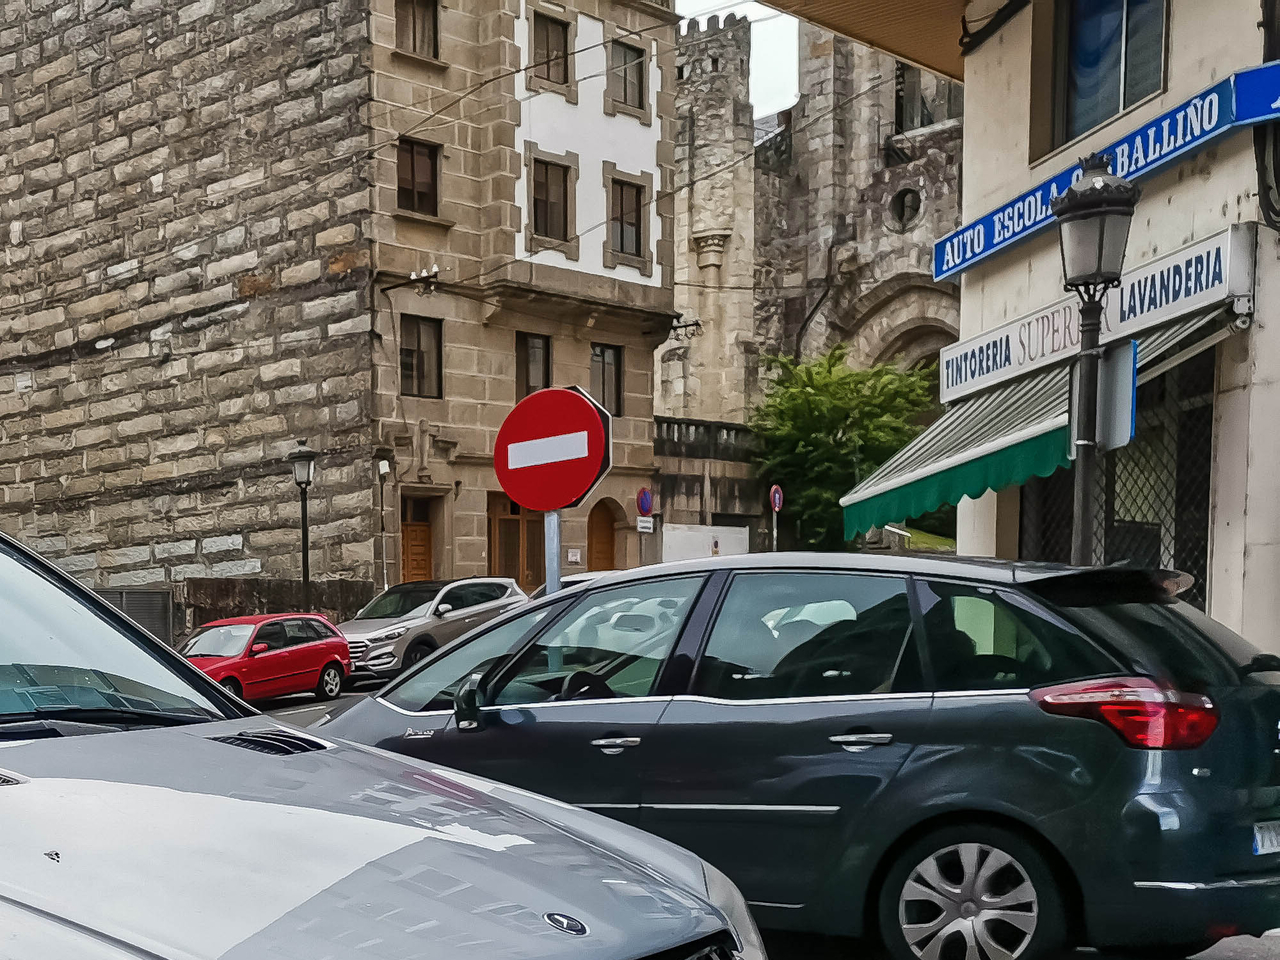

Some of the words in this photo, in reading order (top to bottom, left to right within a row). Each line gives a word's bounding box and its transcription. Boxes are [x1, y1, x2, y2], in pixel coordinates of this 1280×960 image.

[942, 223, 985, 272] AUTO
[1071, 92, 1219, 187] CBALLIÑO
[945, 334, 1012, 389] TINTORERIA
[1120, 246, 1223, 323] LAVANDERIA
